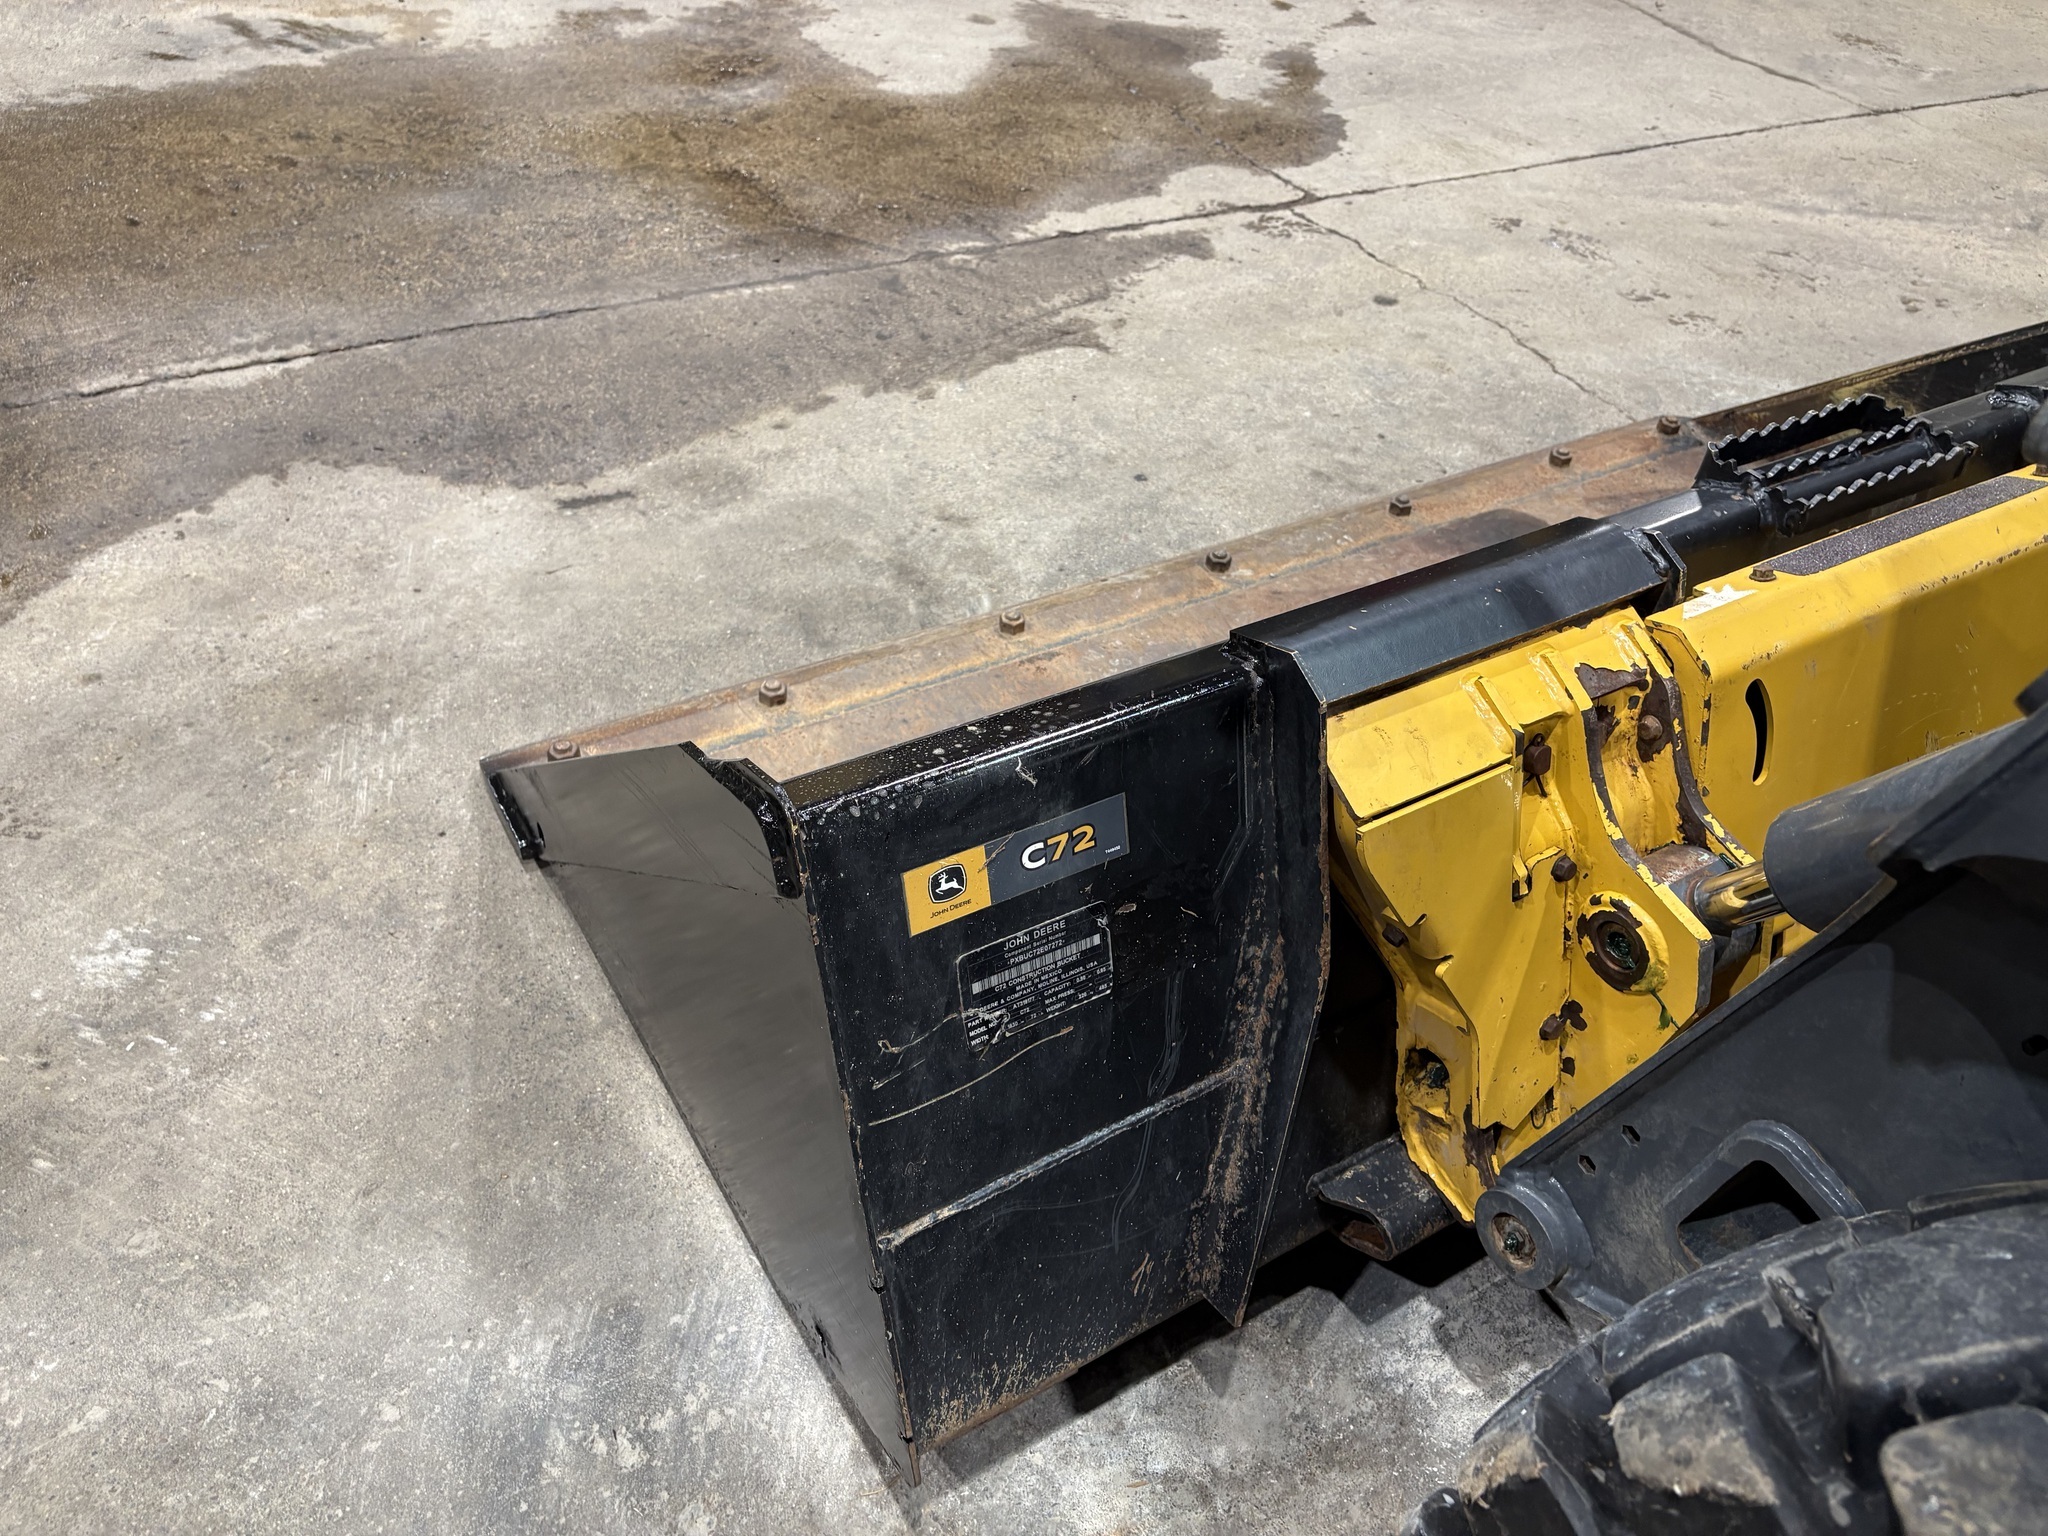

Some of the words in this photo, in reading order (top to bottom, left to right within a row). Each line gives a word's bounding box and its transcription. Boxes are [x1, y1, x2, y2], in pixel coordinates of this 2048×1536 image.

[1021, 824, 1096, 870] C72
[930, 907, 949, 919] JOHN
[949, 898, 972, 911] DEERE
[1003, 934, 1030, 951] JOHN
[1033, 919, 1066, 939] DEERE
[1004, 944, 1032, 959] Component
[1032, 937, 1048, 948] Serial
[1048, 930, 1067, 941] Number
[995, 982, 1007, 992] C72
[1008, 963, 1056, 987] CONSTRUCTION
[1057, 952, 1081, 968] BUCKET
[1015, 980, 1032, 991] MADE
[1040, 968, 1063, 980] MEXICO
[980, 1000, 999, 1013] DEERE
[1085, 960, 1098, 970] USA
[1019, 1007, 1030, 1015] C72
[1044, 995, 1057, 1005] MAX
[967, 1016, 983, 1028] PART
[969, 1025, 988, 1037] MODEL
